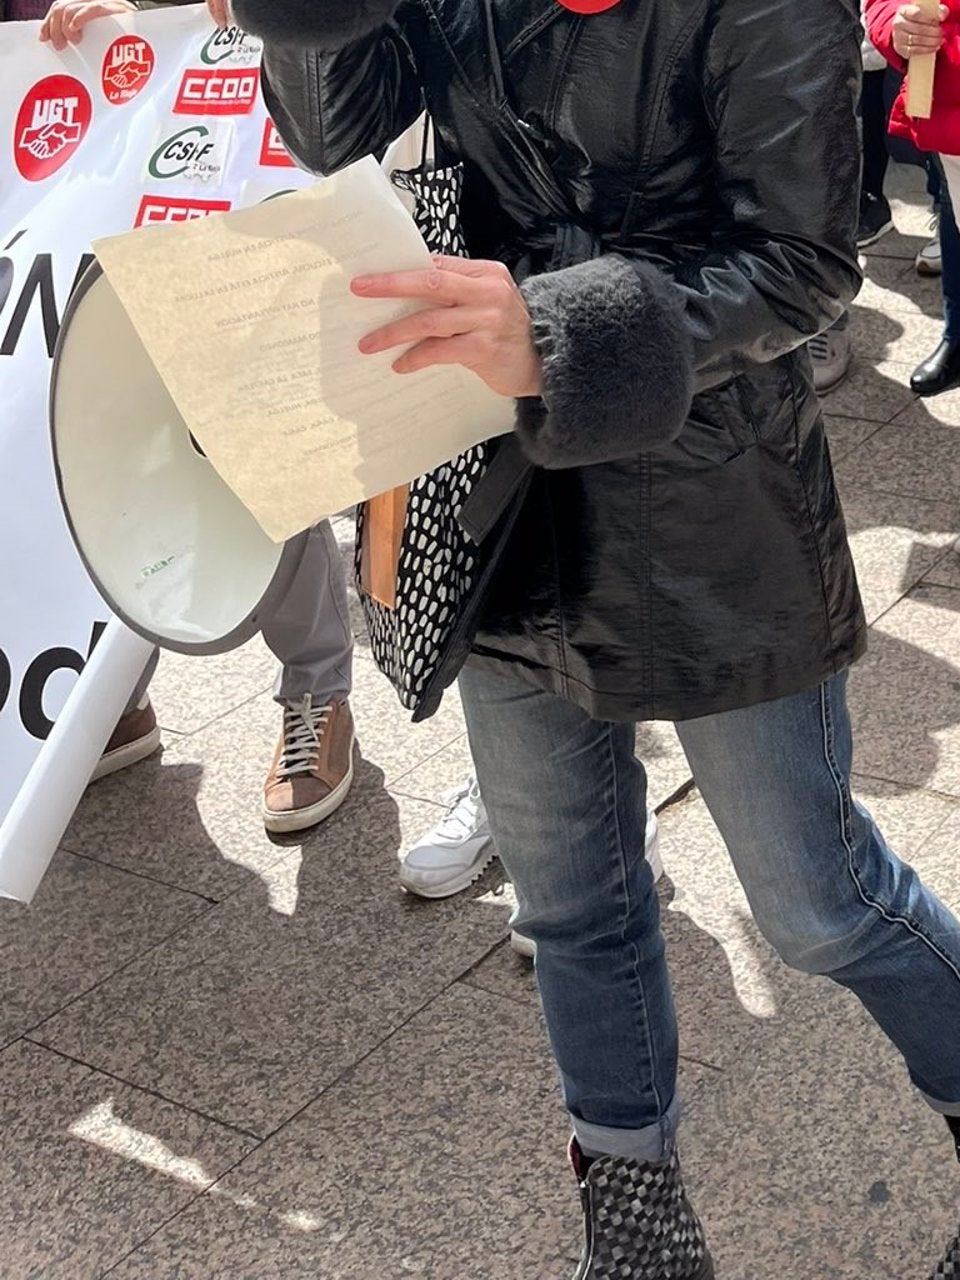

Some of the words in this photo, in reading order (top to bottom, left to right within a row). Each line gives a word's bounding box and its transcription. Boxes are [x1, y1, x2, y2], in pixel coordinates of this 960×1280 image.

[111, 43, 146, 66] UGT
[182, 77, 255, 99] CCOO
[32, 97, 78, 128] UGT
